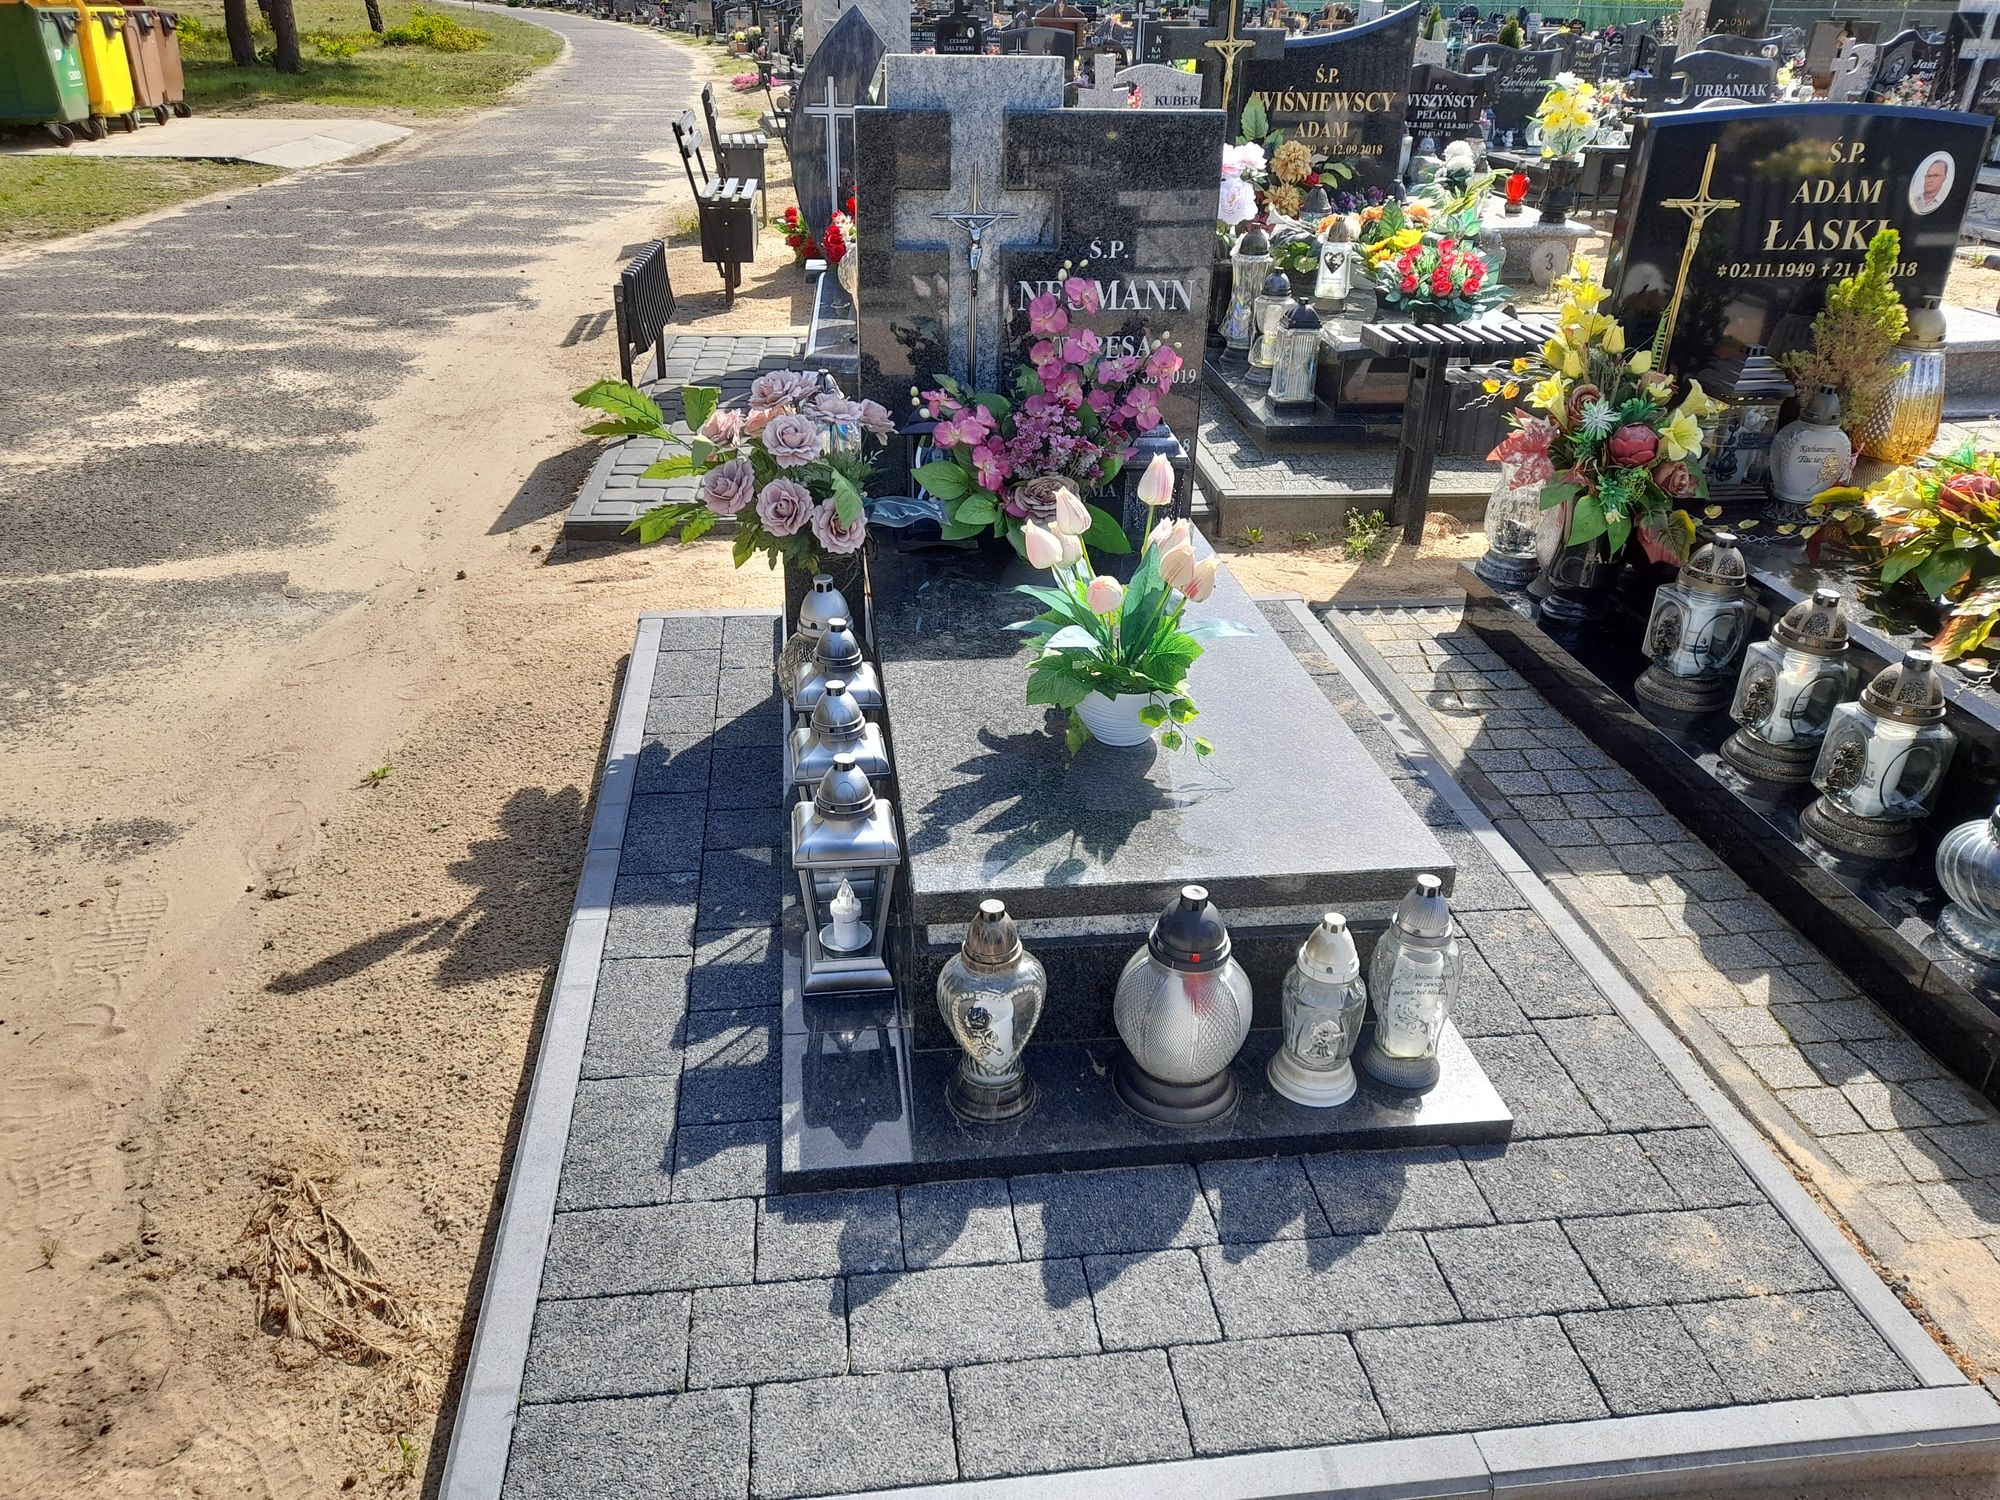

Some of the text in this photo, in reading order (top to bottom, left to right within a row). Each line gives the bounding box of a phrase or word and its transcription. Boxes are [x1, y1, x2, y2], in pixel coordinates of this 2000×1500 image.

[1315, 64, 1340, 84] Ś.P.
[1254, 86, 1397, 112] WIŚNIEWSCY
[1694, 83, 1769, 97] URBANIAK
[1155, 95, 1200, 106] KUBER
[1416, 109, 1457, 120] PELAGIA
[1294, 121, 1350, 139] ADAM
[1332, 144, 1383, 156] 12.09.2018
[1828, 136, 1866, 163] Ś.P.
[1791, 179, 1885, 204] ADAM
[1089, 237, 1129, 259] Ś.P.
[1545, 252, 1554, 271] 3
